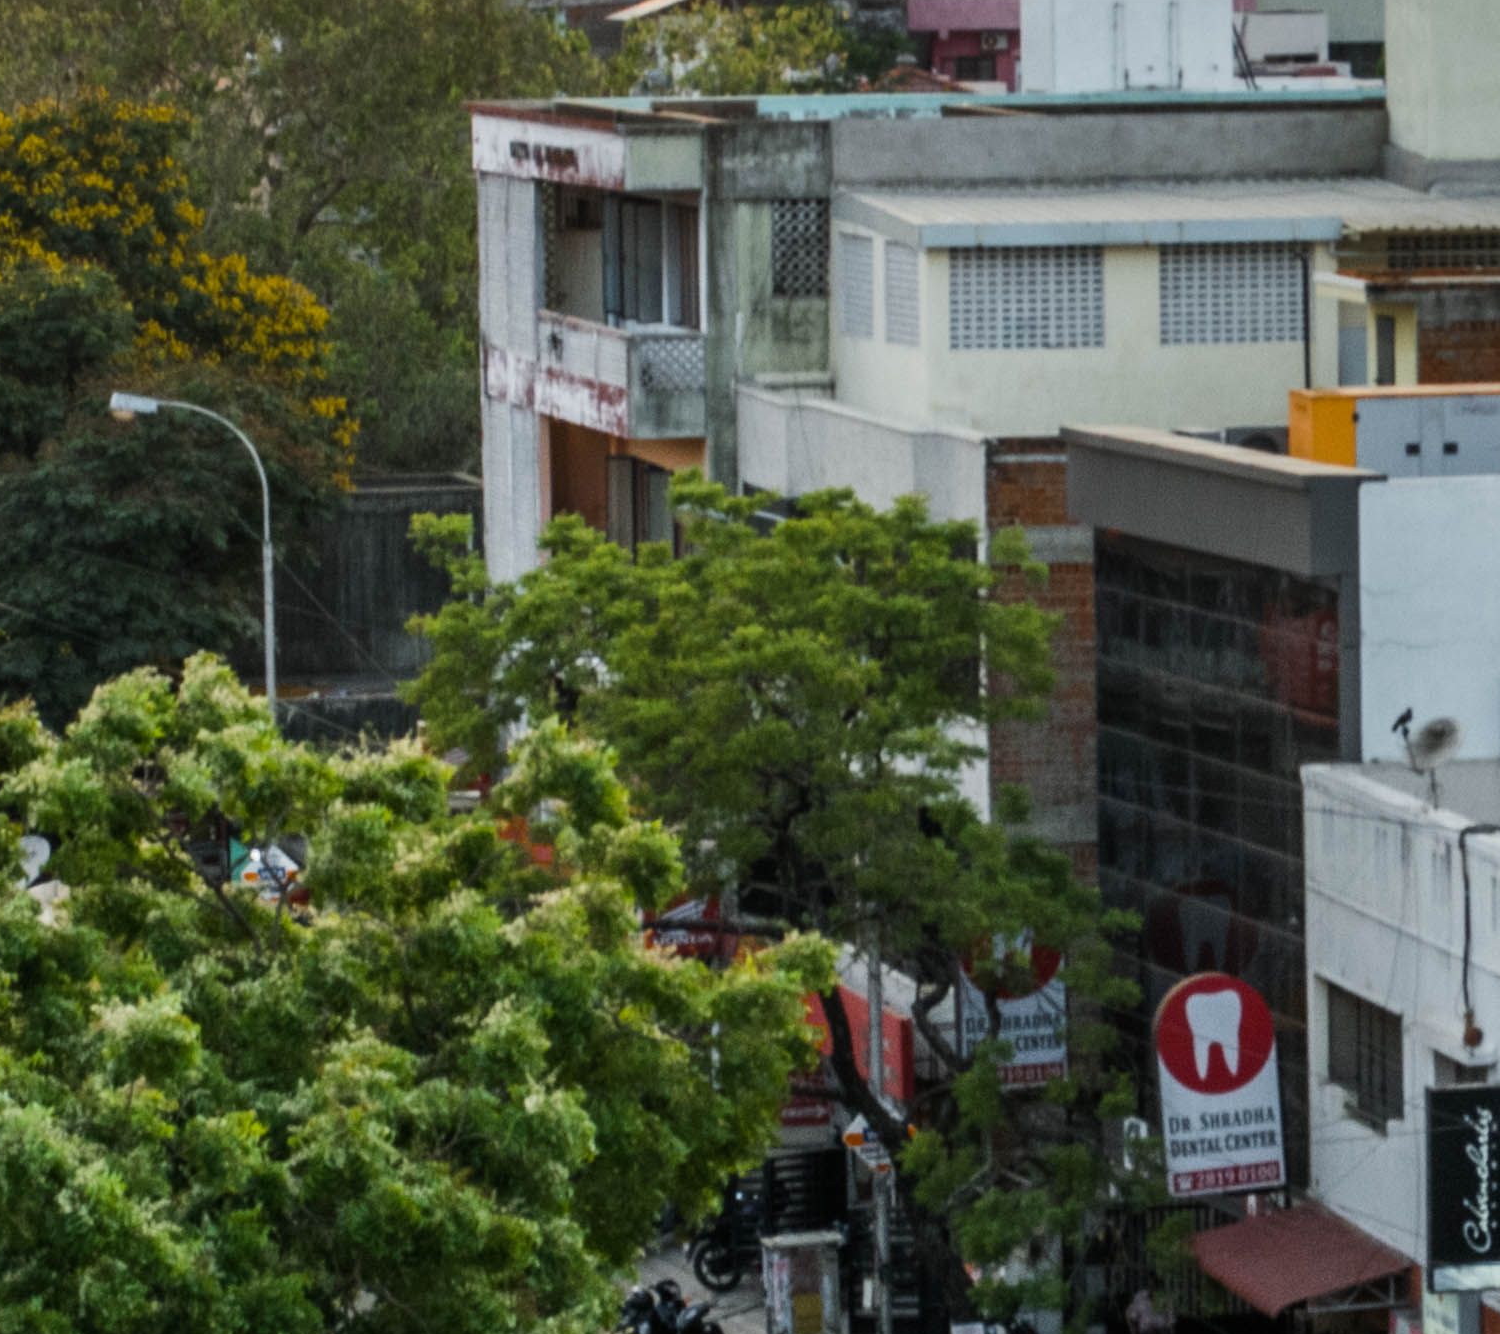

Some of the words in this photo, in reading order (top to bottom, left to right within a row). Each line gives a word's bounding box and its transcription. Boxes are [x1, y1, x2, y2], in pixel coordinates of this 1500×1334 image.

[1199, 1106, 1276, 1132] SHRADHA
[1170, 1136, 1223, 1159] DENTAL
[1224, 1130, 1278, 1153] CENTER
